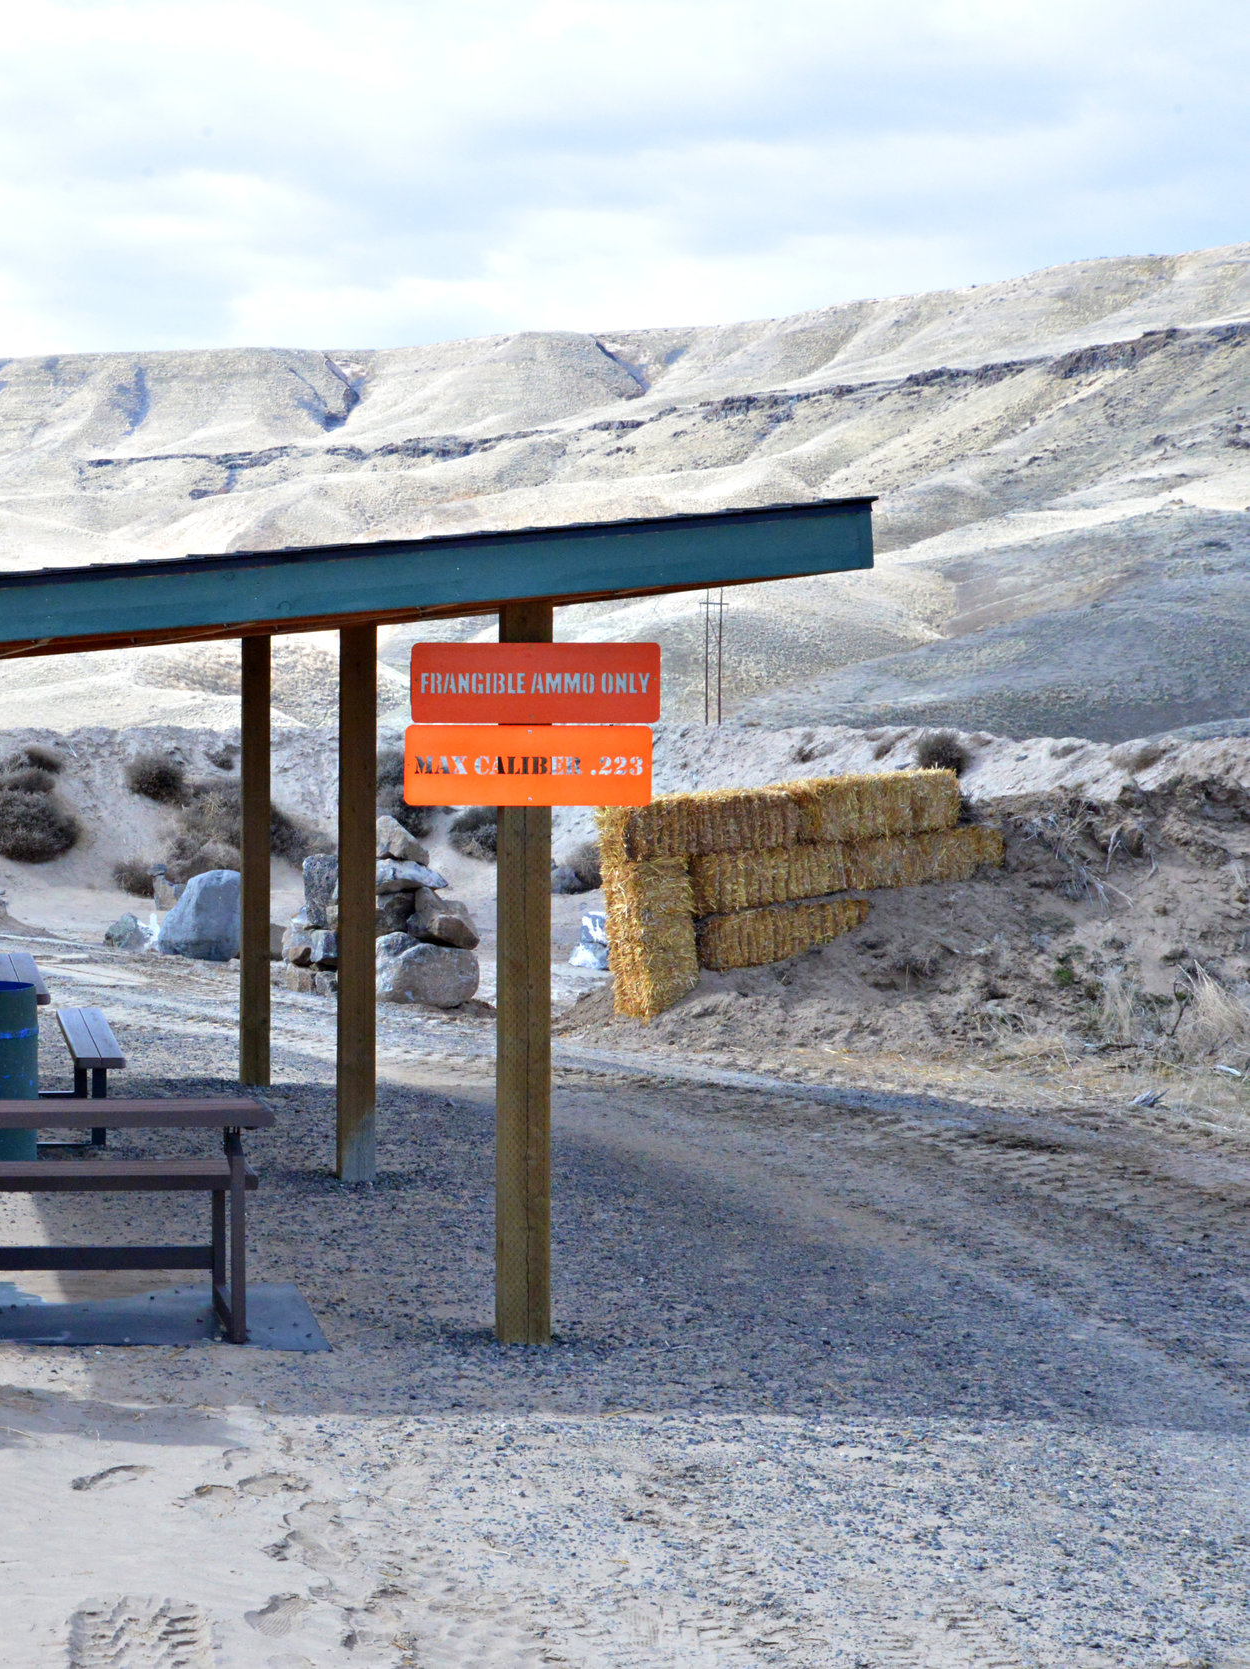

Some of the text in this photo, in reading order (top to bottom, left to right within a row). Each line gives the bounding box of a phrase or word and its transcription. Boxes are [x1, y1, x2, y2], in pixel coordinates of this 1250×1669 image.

[420, 672, 651, 694] FRANGIBLE AMMO ONLY
[414, 756, 644, 776] MAX CALIBER .223
